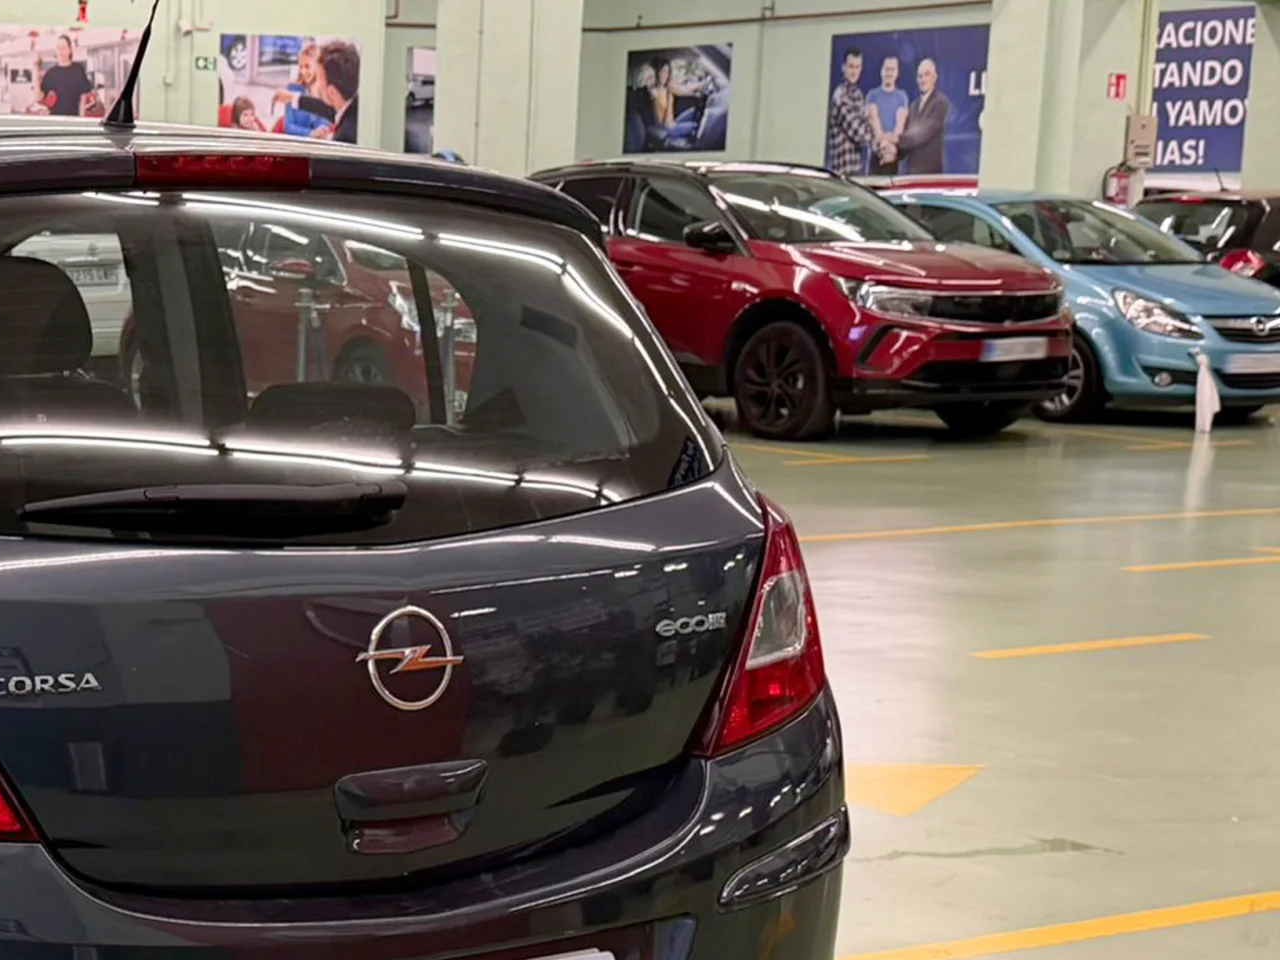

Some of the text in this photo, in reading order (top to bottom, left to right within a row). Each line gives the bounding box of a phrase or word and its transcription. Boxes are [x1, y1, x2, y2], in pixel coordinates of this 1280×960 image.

[1157, 18, 1255, 48] ACIONE
[1154, 59, 1243, 88] TANDO
[1166, 98, 1248, 127] YAMO
